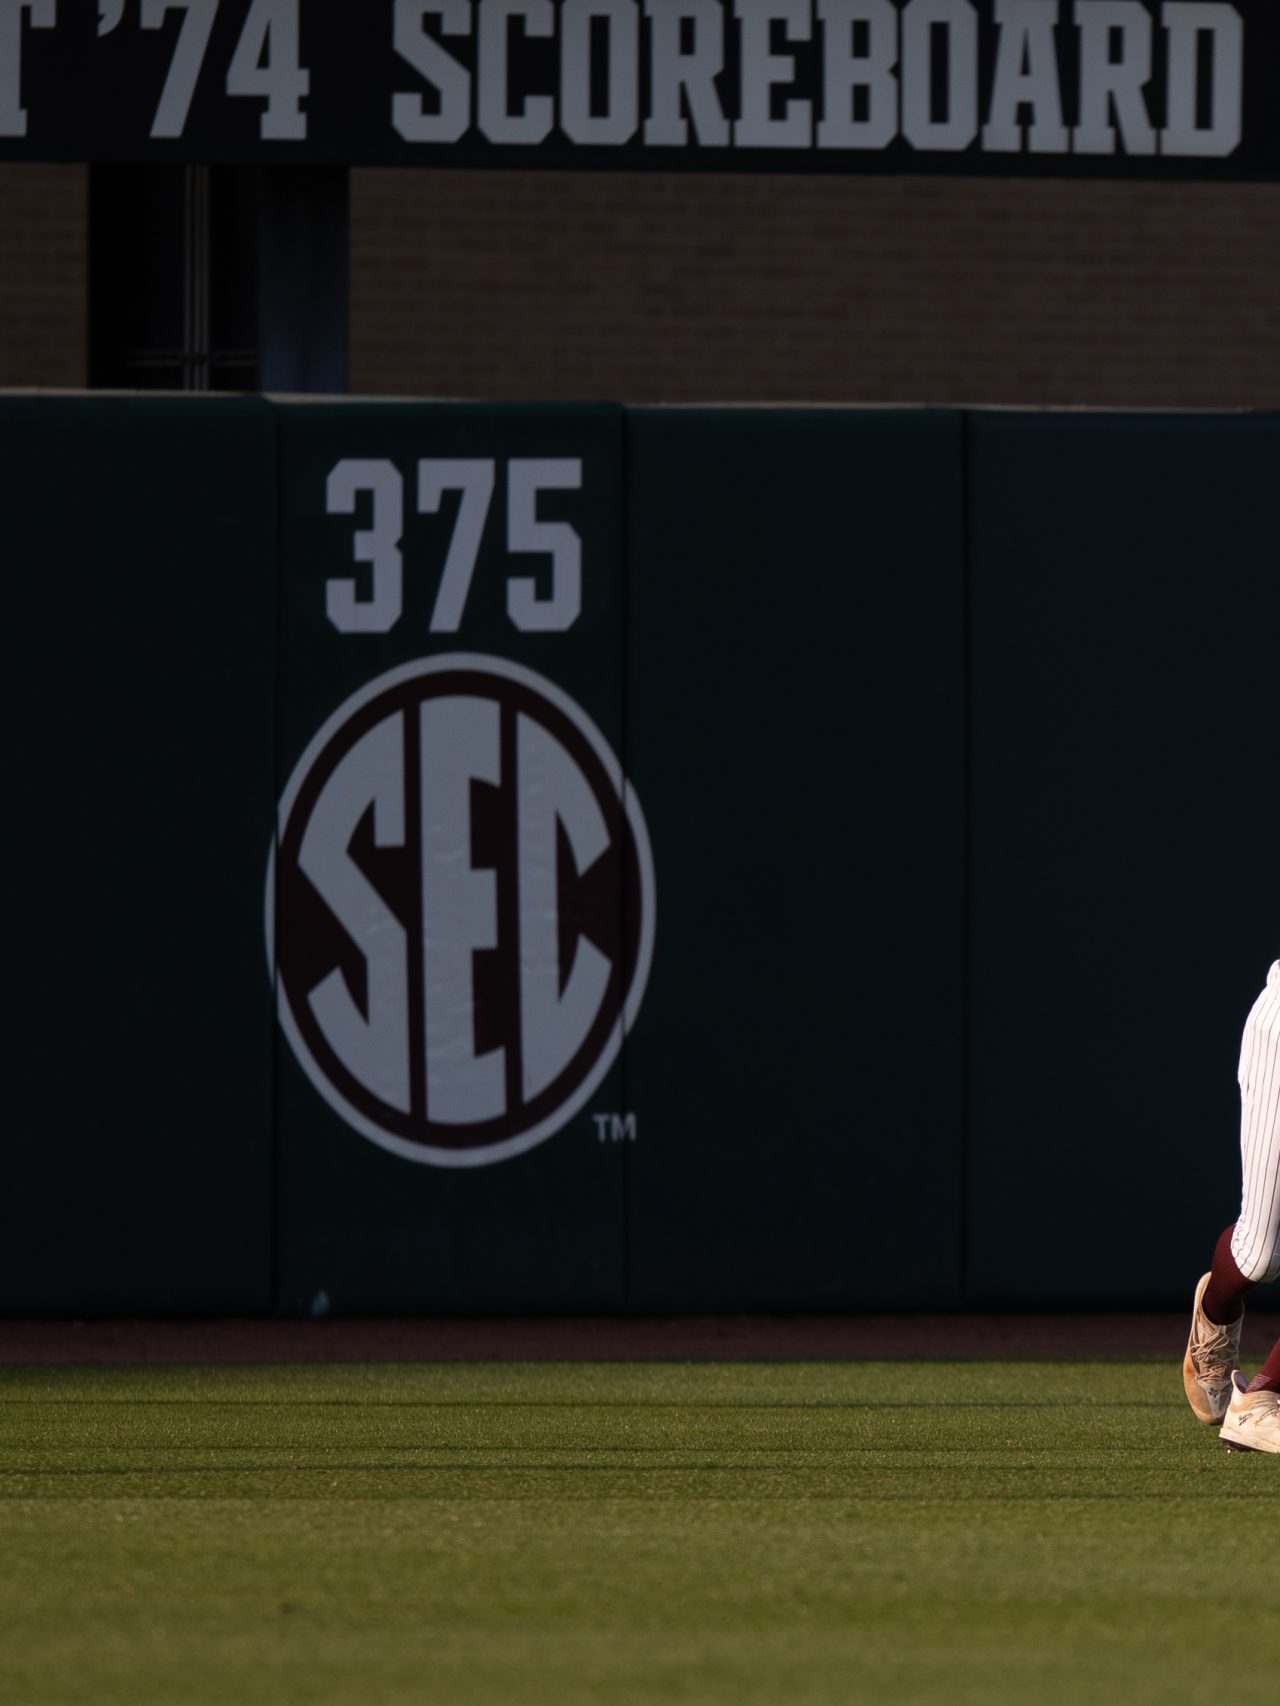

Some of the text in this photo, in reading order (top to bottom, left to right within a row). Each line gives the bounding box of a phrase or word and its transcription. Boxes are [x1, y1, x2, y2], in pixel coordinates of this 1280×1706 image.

[392, 0, 1243, 157] SCOREBOARD
[326, 458, 582, 633] 375
[298, 696, 613, 1124] SEC
[593, 1113, 636, 1142] TM
